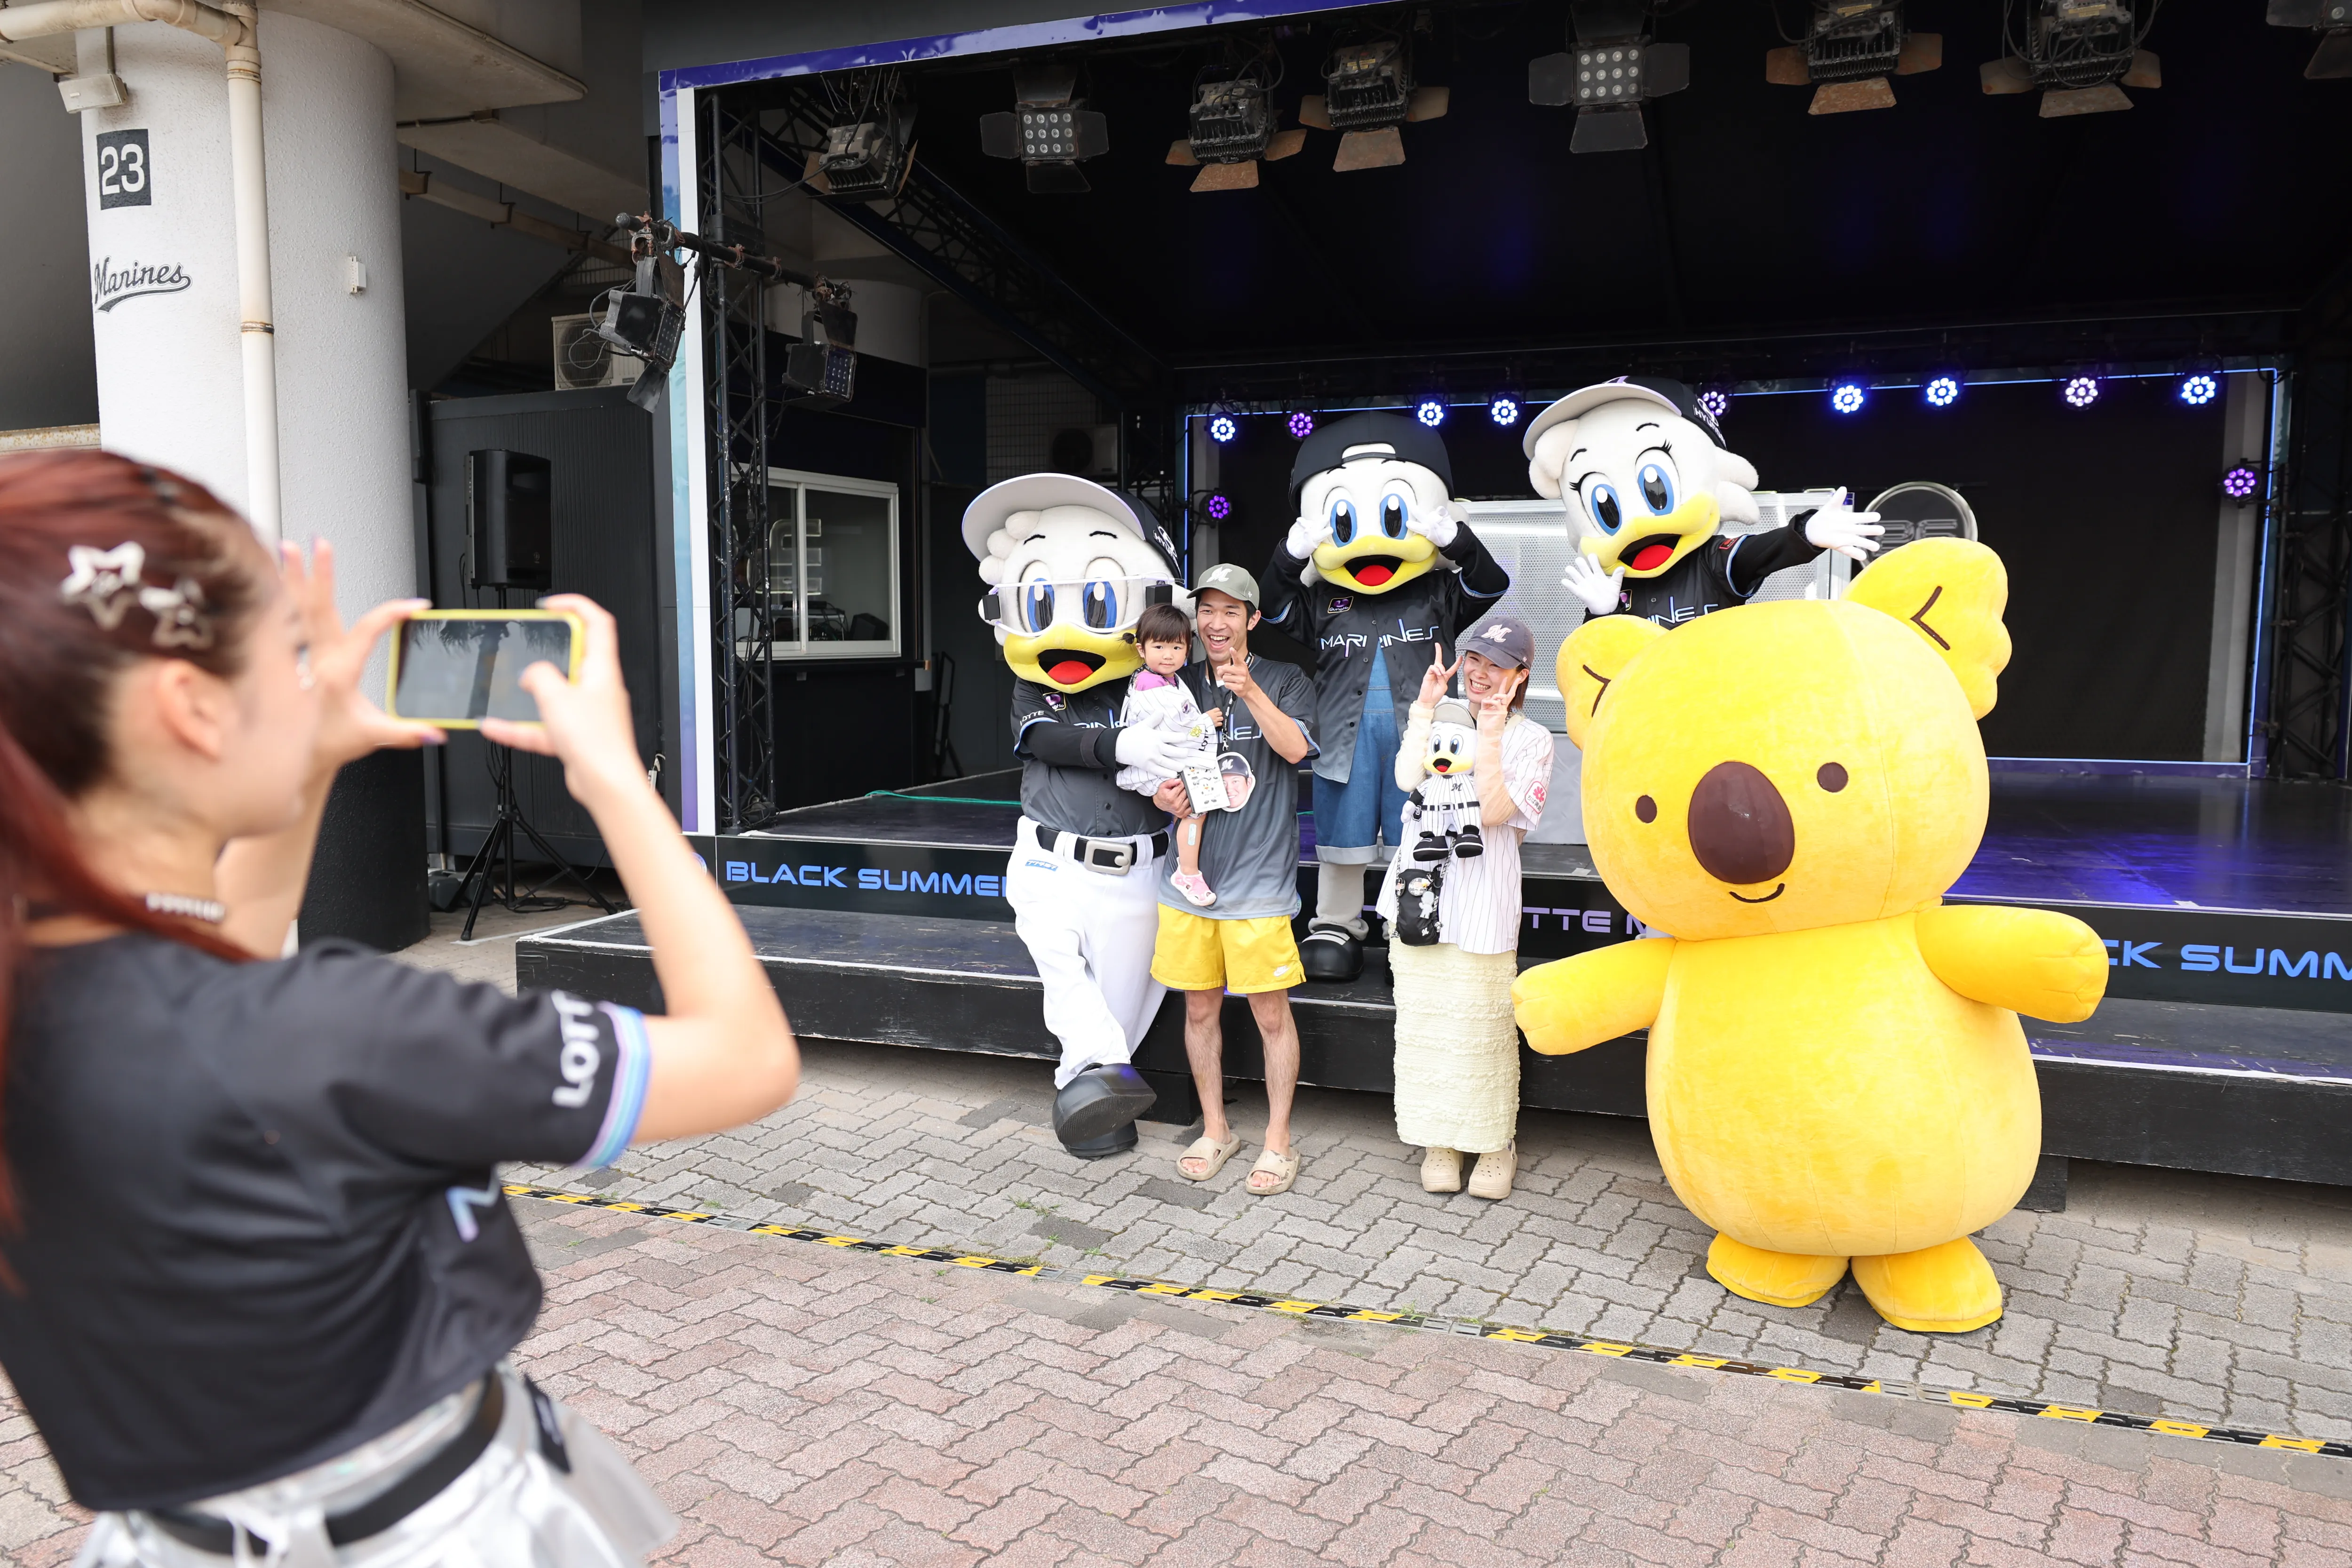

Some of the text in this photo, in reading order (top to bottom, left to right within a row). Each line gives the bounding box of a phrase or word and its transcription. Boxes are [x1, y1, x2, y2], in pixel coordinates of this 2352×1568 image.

[100, 143, 145, 196] 23
[95, 255, 191, 312] Marines
[1481, 624, 1512, 643] M
[1451, 783, 1463, 791] M
[726, 860, 848, 888] BLACK
[858, 868, 1008, 897] SUMME
[1522, 907, 1611, 933] TTE
[2180, 944, 2352, 981] SUMM
[551, 990, 600, 1108] LOTT
